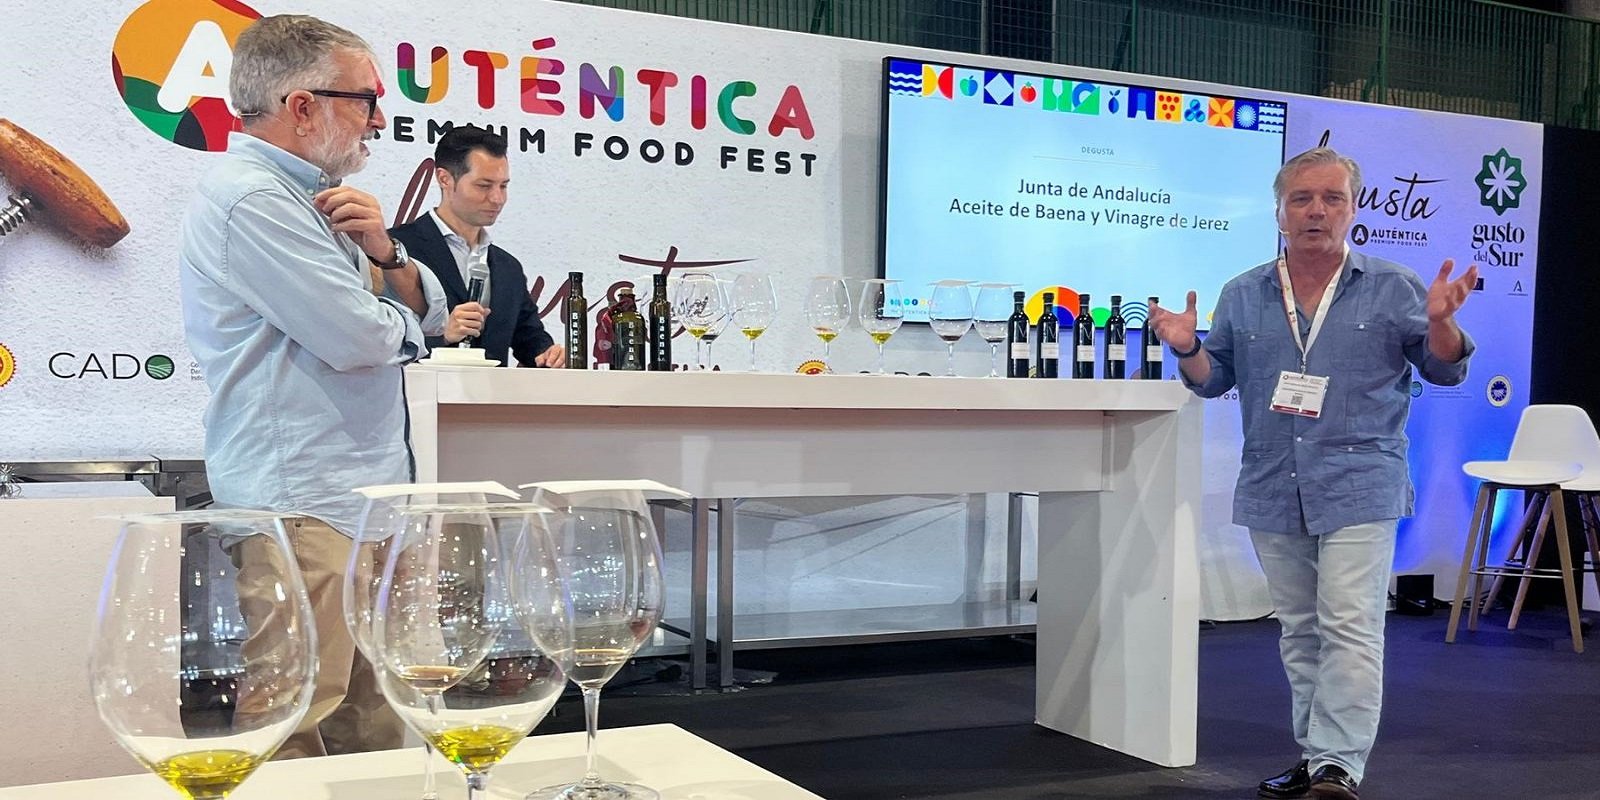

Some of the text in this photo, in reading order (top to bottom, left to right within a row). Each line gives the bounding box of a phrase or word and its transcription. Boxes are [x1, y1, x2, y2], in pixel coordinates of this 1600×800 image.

[373, 37, 815, 140] UTÉNTICA
[574, 132, 695, 167] FOOD
[720, 146, 817, 177] FEST
[1081, 146, 1115, 156] DEGUSTA
[1017, 178, 1171, 205] Junta de Andalucía
[949, 198, 1229, 231] Aceite de Baena y Vinagre de Jerez
[1371, 227, 1427, 241] AUTÉNTICA
[1471, 221, 1525, 249] gusto
[1474, 243, 1524, 267] del Sur
[49, 352, 175, 380] CADO
